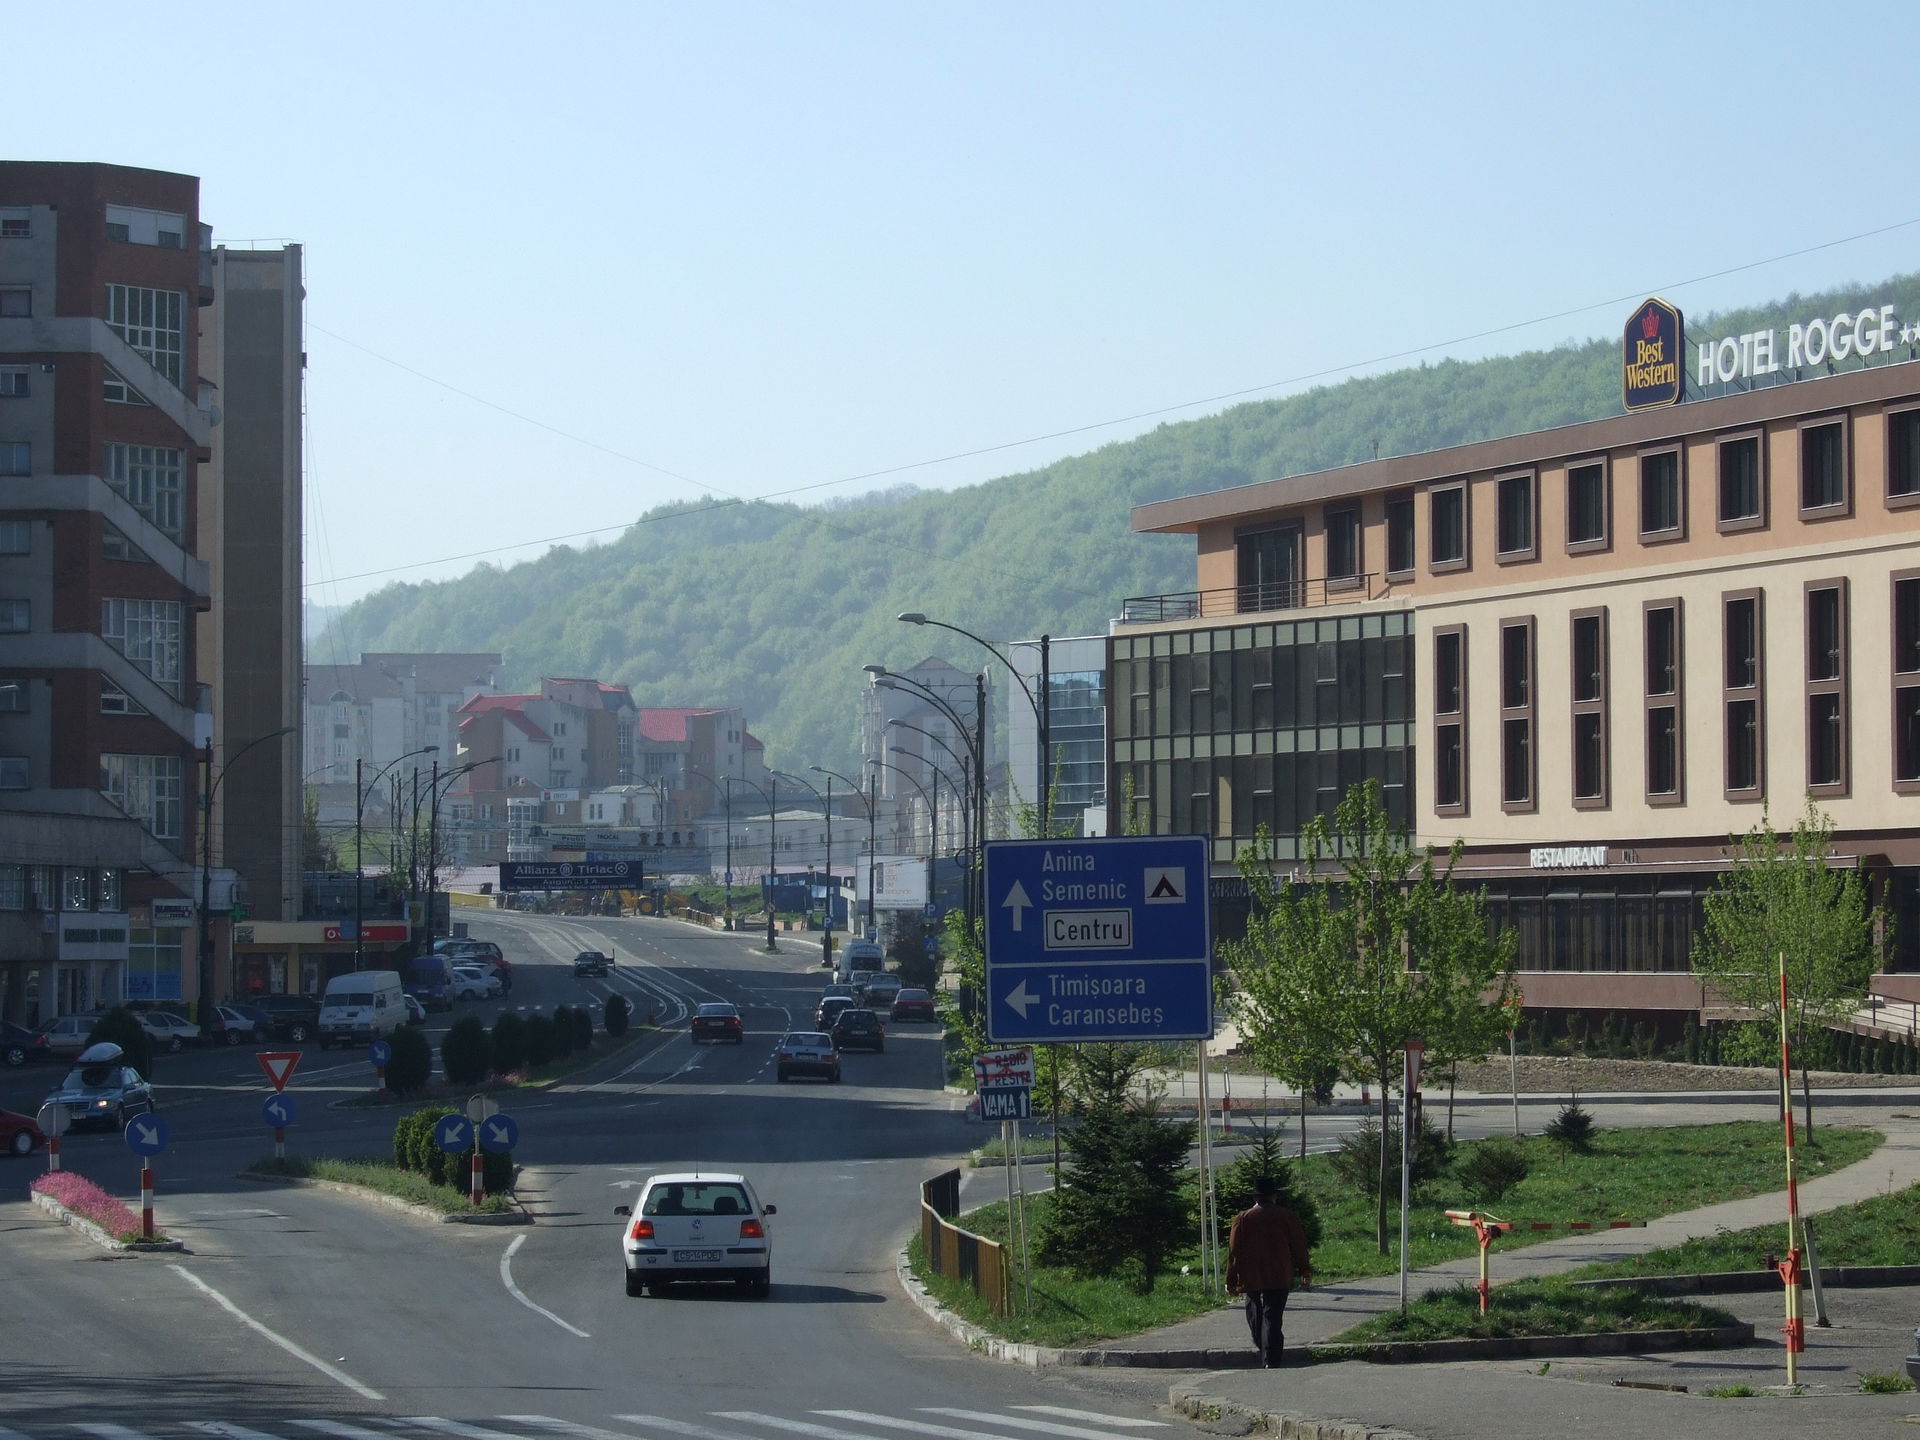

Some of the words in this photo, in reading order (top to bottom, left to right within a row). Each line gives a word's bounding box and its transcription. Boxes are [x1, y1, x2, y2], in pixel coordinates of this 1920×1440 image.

[1635, 336, 1664, 366] Best
[1698, 327, 1781, 387] HOTEL
[1787, 304, 1896, 369] ROGGE
[1625, 361, 1676, 391] Western
[1042, 849, 1095, 872] Anina
[1530, 846, 1609, 867] RESTAURANT
[515, 865, 557, 875] Allianz
[1042, 877, 1127, 902] Semenic
[1054, 918, 1123, 942] Centru
[995, 1052, 1026, 1068] RADIO
[982, 1093, 1017, 1117] VAMA
